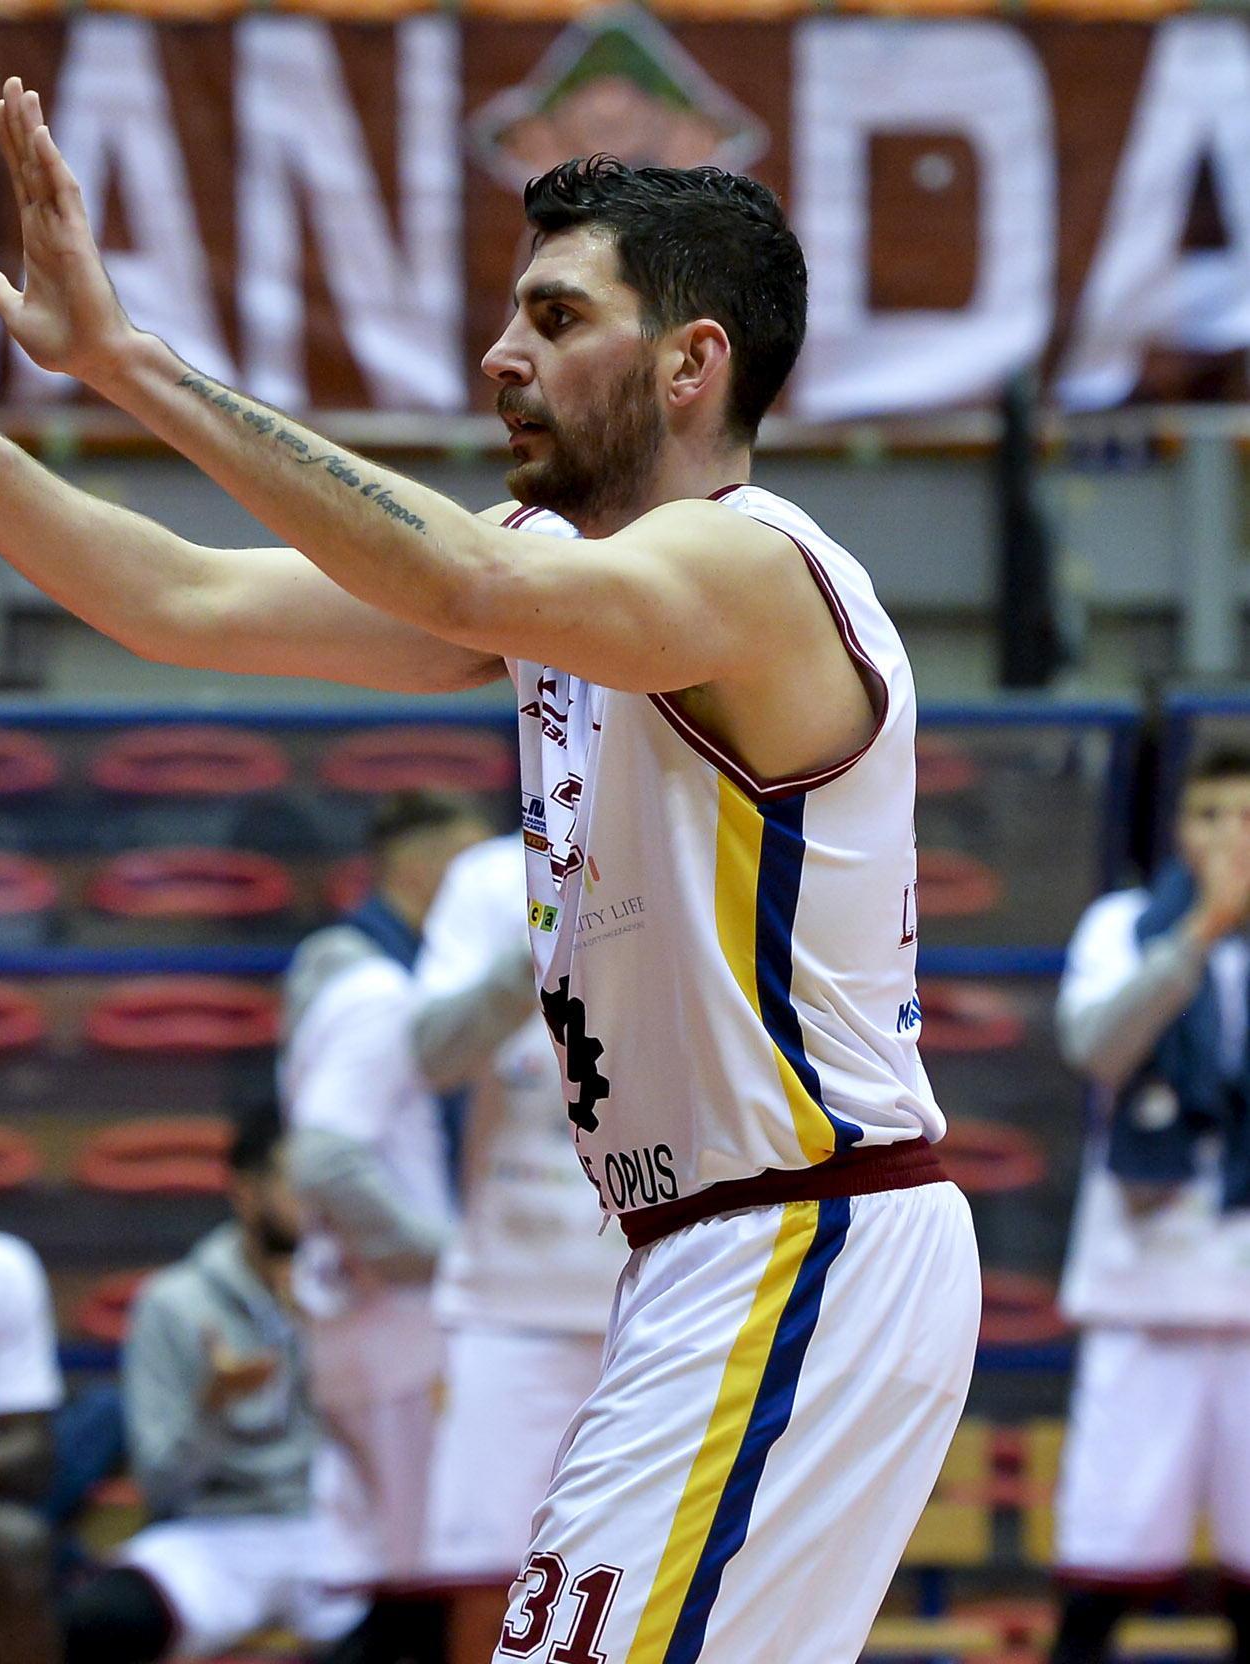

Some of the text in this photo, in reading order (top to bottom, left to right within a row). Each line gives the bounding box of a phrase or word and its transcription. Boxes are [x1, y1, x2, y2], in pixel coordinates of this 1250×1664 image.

[577, 896, 646, 934] ITY LIFE
[604, 1143, 680, 1211] OPUS
[498, 1551, 625, 1664] 31
